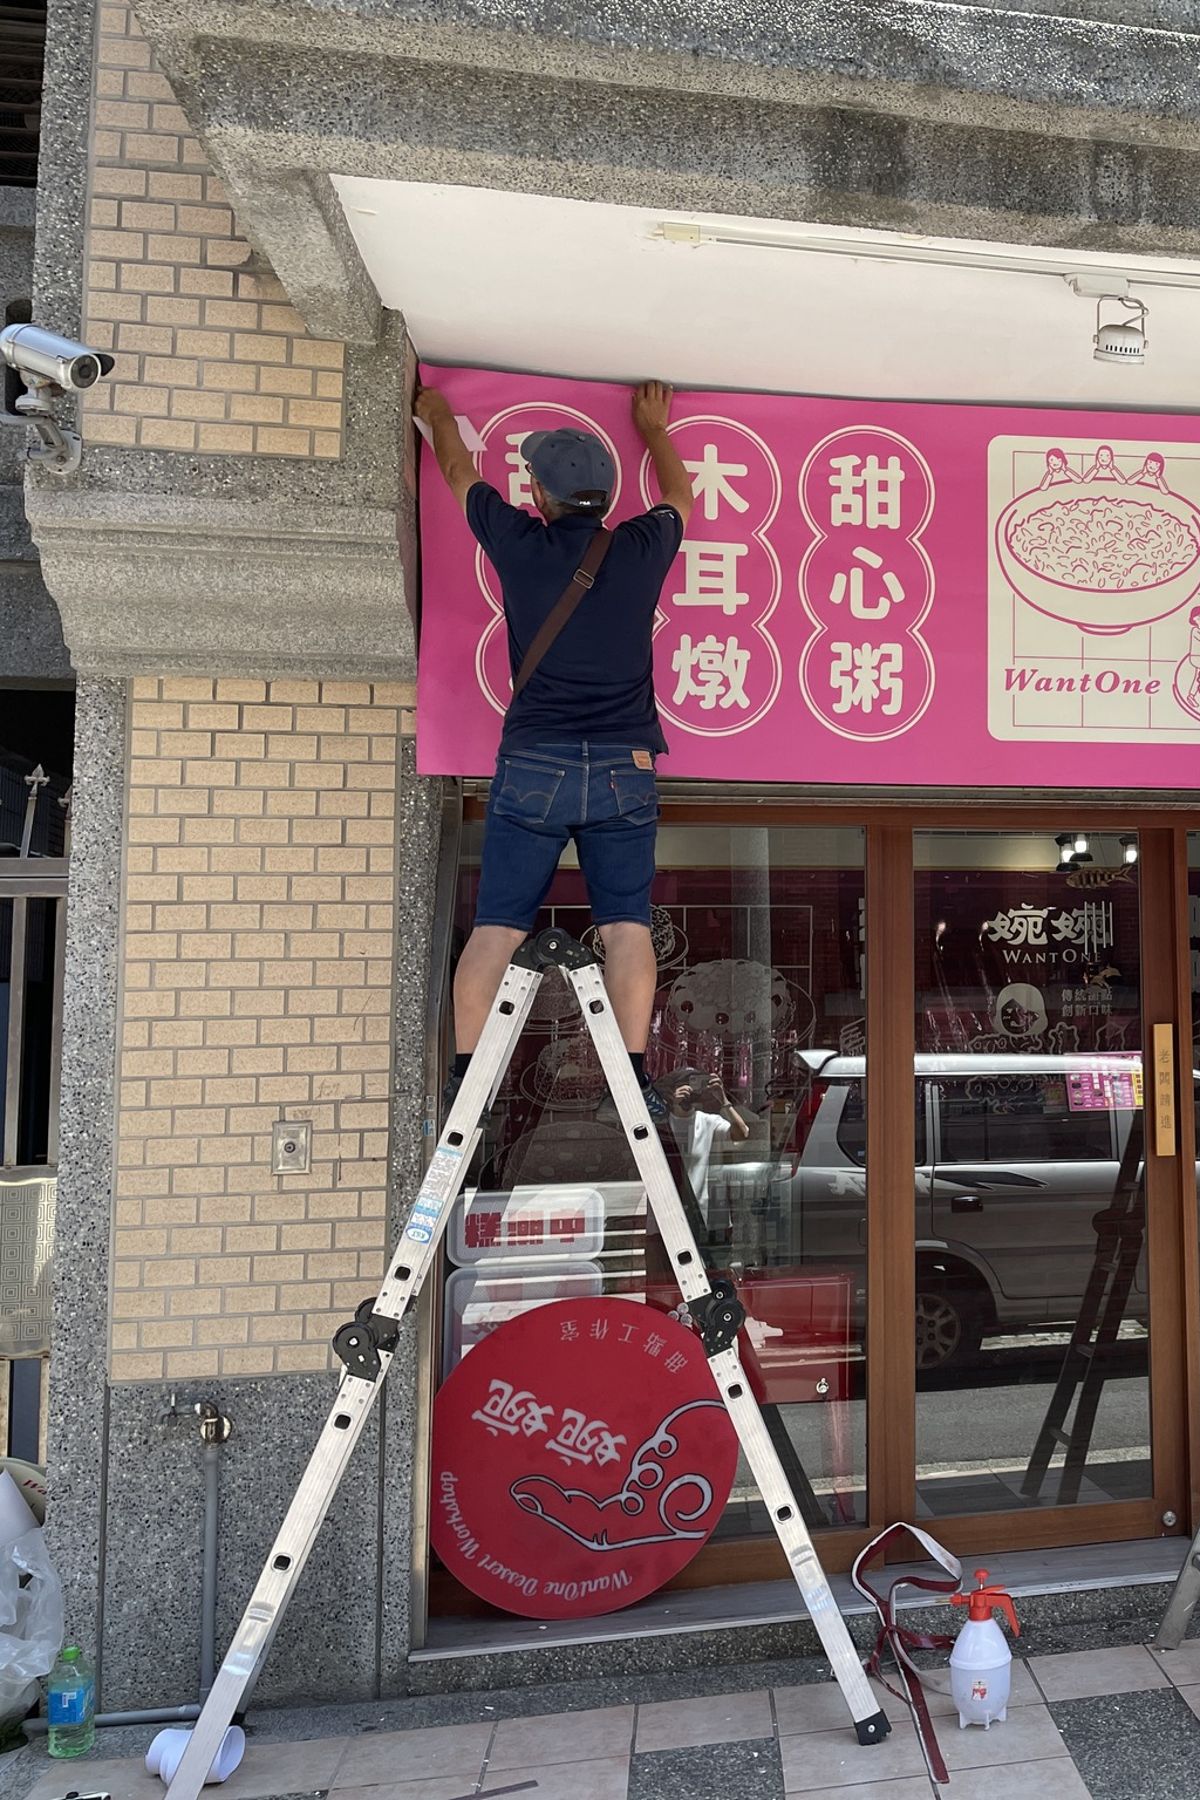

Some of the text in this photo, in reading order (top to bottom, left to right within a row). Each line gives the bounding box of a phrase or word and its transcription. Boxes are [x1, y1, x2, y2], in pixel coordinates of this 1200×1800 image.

[672, 444, 751, 710] 木耳燉
[828, 454, 905, 716] 甜心粥
[1003, 668, 1161, 695] WantOne
[560, 1318, 688, 1374] 甜點工作室
[440, 1471, 632, 1600] WantOne Dessert Workshop
